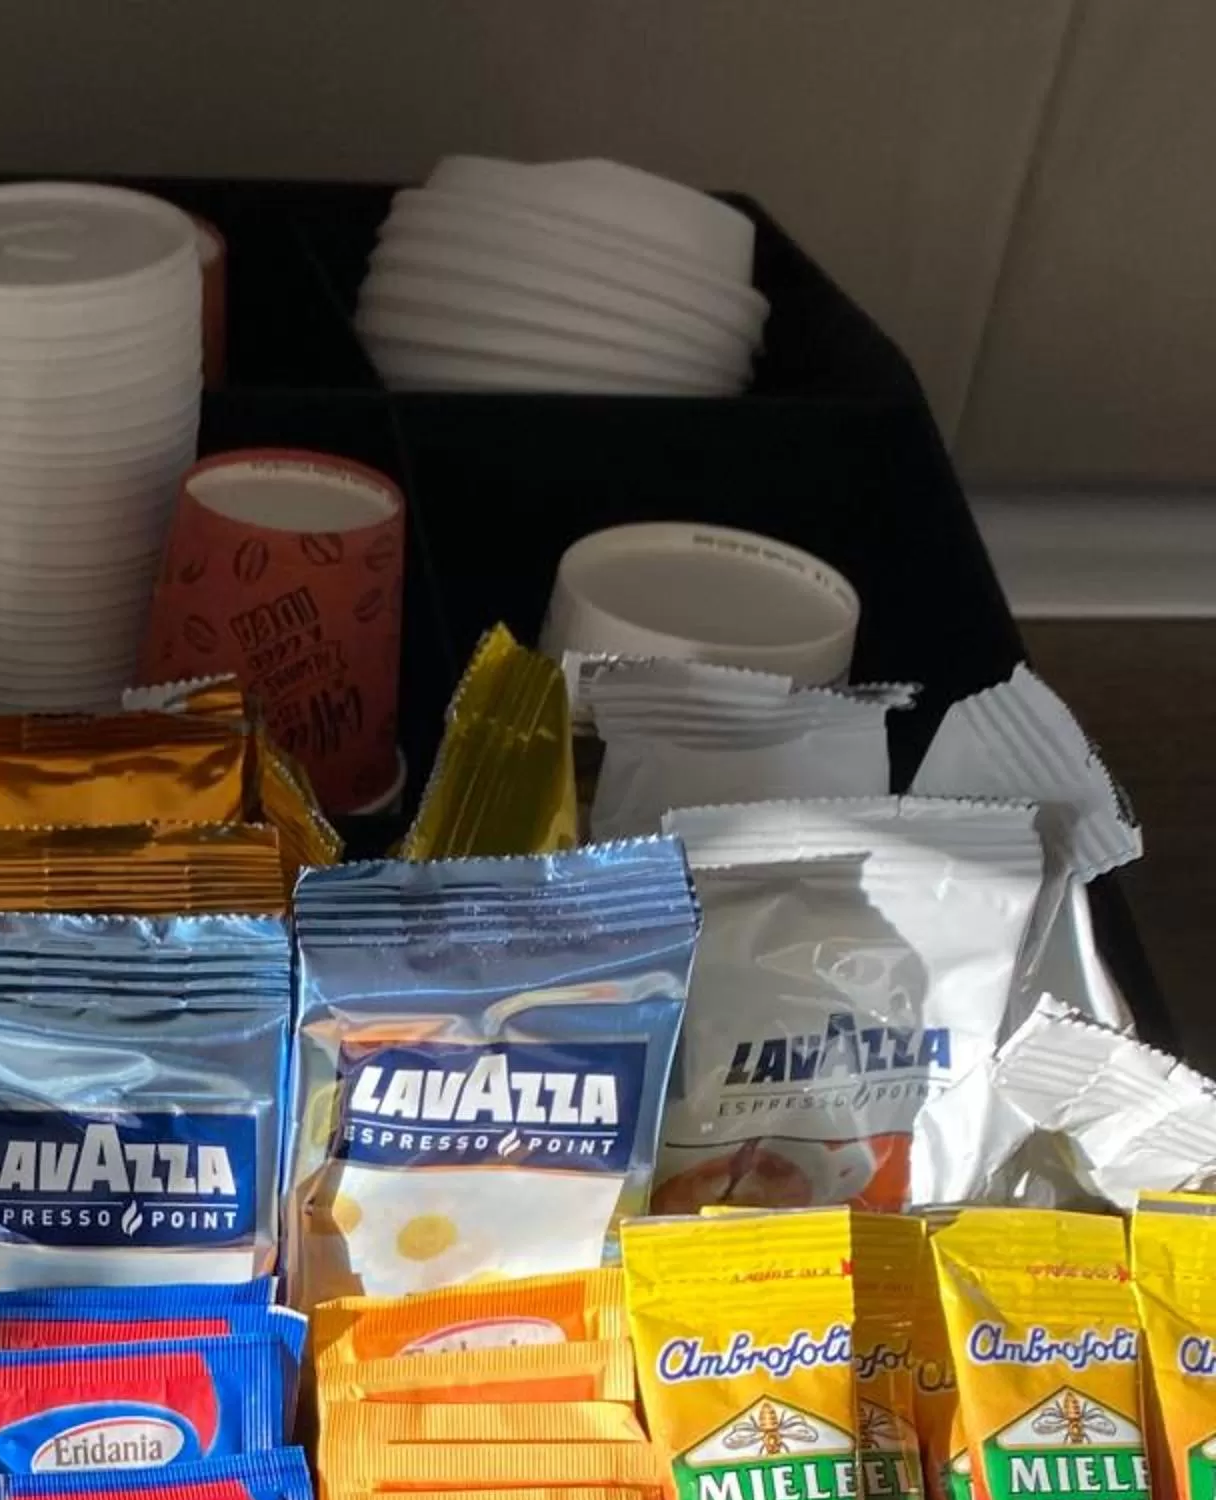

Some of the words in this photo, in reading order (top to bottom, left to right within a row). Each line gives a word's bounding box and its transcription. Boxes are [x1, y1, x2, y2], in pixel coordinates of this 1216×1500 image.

[724, 1011, 952, 1085] LAVAZZA
[350, 1053, 618, 1124] LAVAZZA
[718, 1095, 848, 1117] ESPRESSO
[344, 1126, 489, 1152] ESPRESSO
[528, 1139, 615, 1155] POINT
[152, 1211, 237, 1229] POINT
[54, 1433, 164, 1467] Eridania
[1010, 1454, 1150, 1494] MIELE
